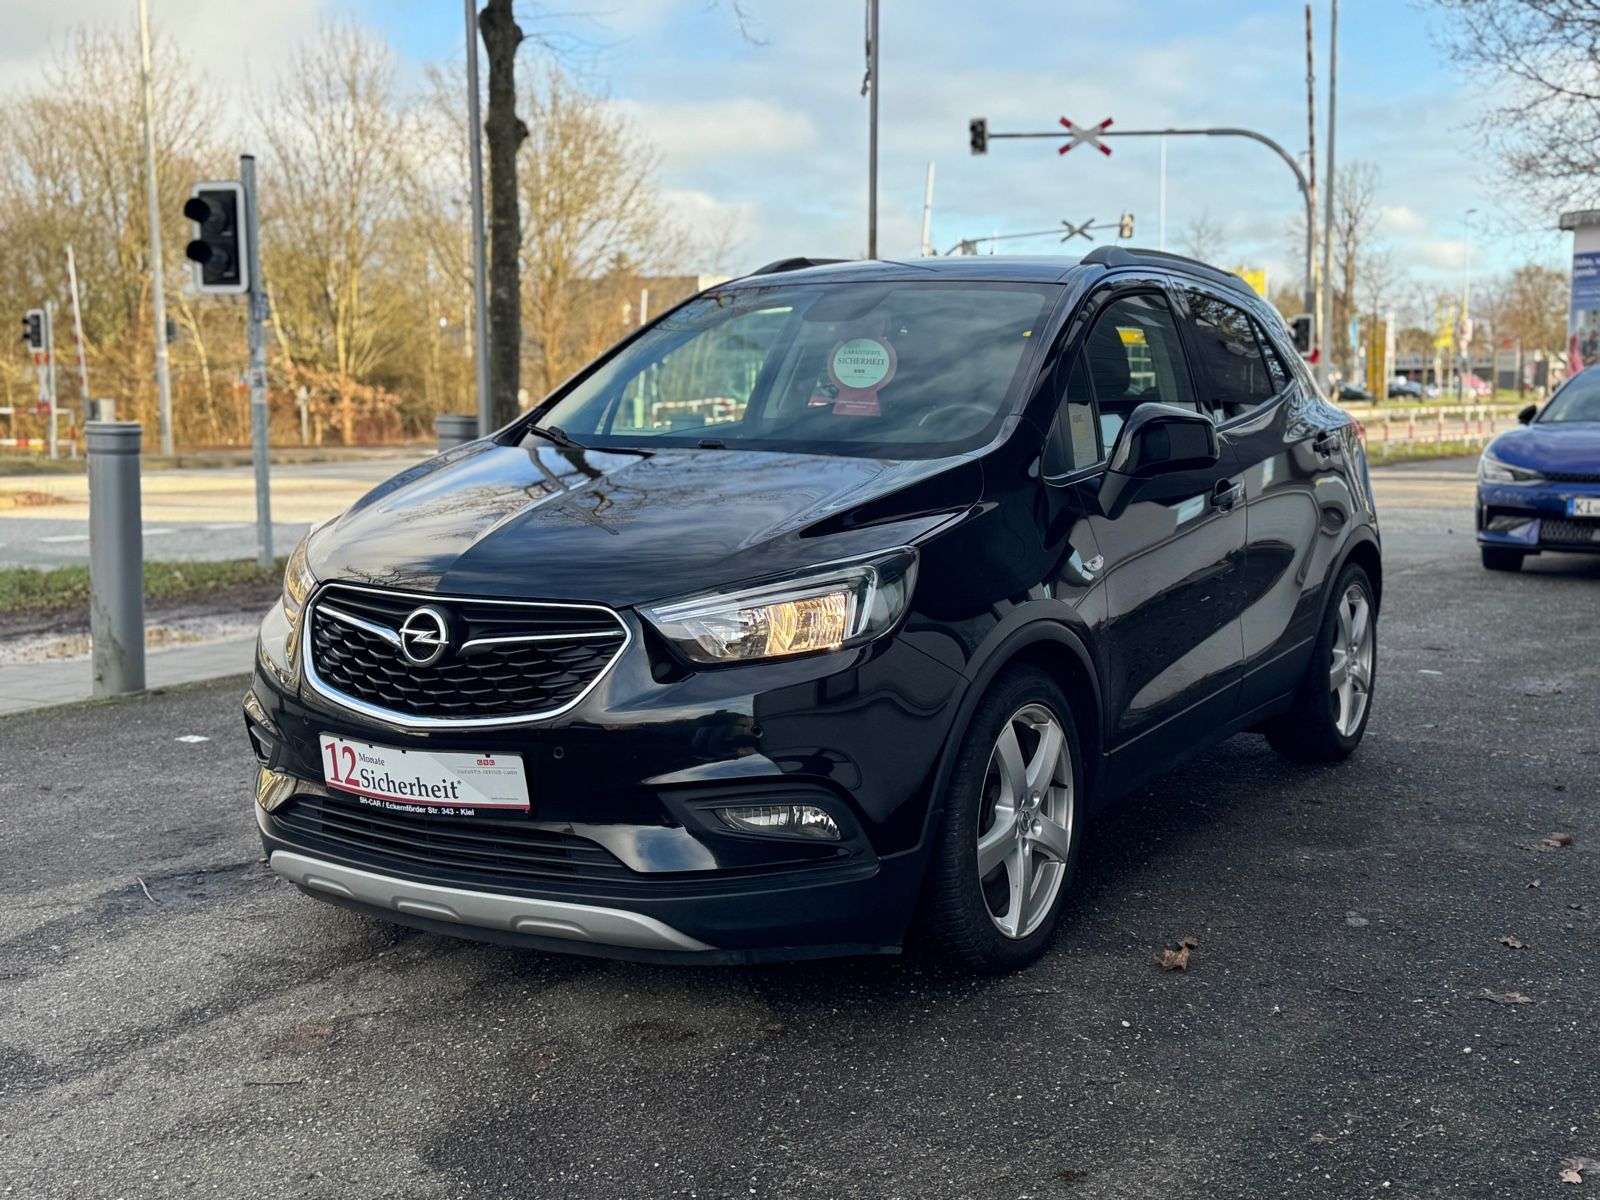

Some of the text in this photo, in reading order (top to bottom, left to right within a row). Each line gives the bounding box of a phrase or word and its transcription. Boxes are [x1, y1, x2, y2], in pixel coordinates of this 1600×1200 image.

[838, 357, 886, 365] SICHERHEIT
[325, 742, 360, 786] 12
[358, 753, 385, 767] Monate
[386, 802, 426, 814] Eckernförder
[427, 806, 440, 815] Str.
[441, 808, 454, 816] 343
[460, 808, 475, 816] Kiel
